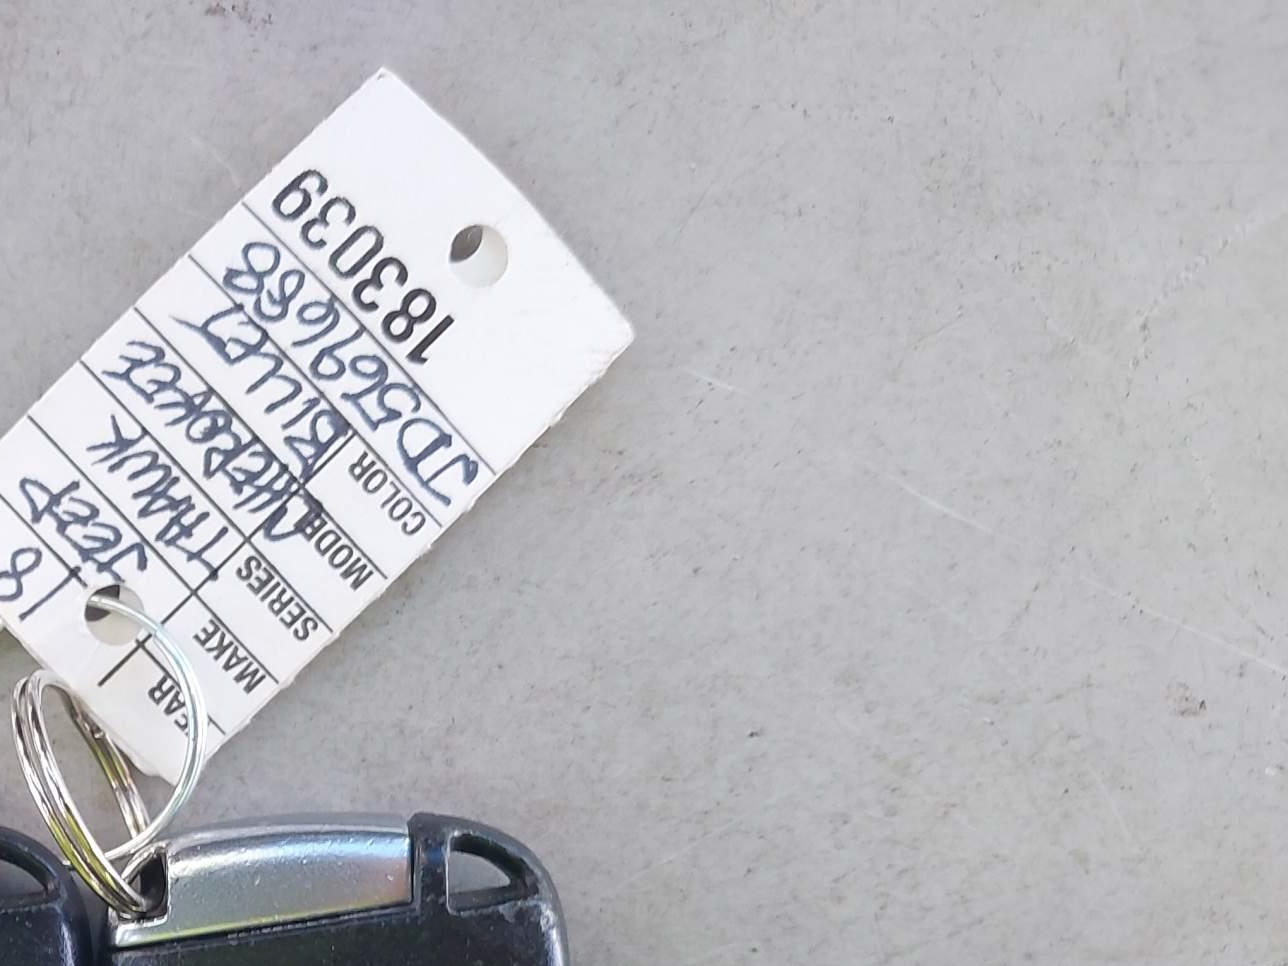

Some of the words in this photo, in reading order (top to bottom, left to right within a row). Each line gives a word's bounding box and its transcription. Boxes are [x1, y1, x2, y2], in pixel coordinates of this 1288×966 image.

[271, 168, 455, 366] 183039
[101, 340, 323, 542] CHEROKEE
[19, 476, 148, 584] JEEP
[348, 450, 427, 537] COLOR
[235, 555, 319, 641] SERIES
[193, 618, 267, 695] MAKE
